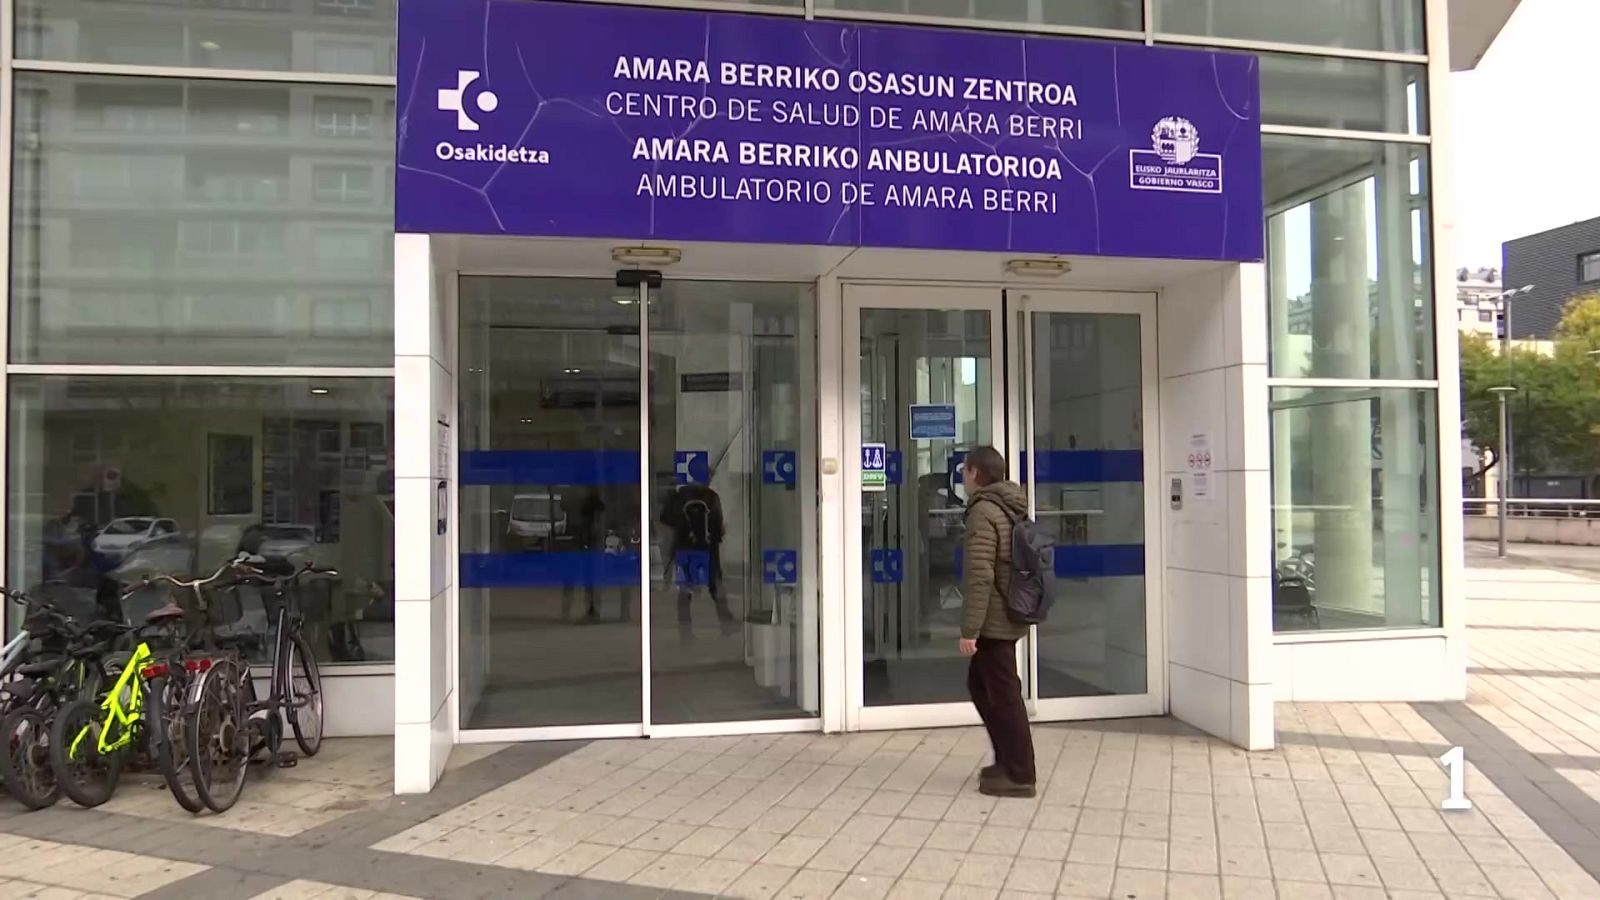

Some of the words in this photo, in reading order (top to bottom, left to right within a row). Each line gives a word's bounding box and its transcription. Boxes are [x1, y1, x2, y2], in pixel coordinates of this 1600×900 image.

[613, 56, 710, 84] AMARA
[720, 62, 841, 91] BERRIKO
[848, 70, 954, 98] OSASUN
[963, 77, 1077, 106] ZENTROA
[606, 91, 717, 120] CENTRO
[728, 98, 762, 121] DE
[772, 101, 860, 127] SALUD
[870, 106, 902, 129] DE
[912, 109, 1000, 134] AMARA
[1009, 114, 1083, 140] BERRI
[435, 142, 550, 164] Osakidetza
[632, 137, 729, 164] AMARA
[739, 142, 859, 170] BERRIKO
[867, 149, 1063, 180] ANBULATORIOA
[1135, 164, 1162, 174] EUSKO
[1164, 166, 1217, 177] JAURLARITZA
[636, 174, 831, 203] AMBULATORIO
[841, 182, 875, 205] DE
[884, 184, 974, 209] AMARA
[983, 189, 1057, 213] BERRI
[1138, 177, 1184, 187] GOBIERNO
[1186, 180, 1214, 188] VASCO
